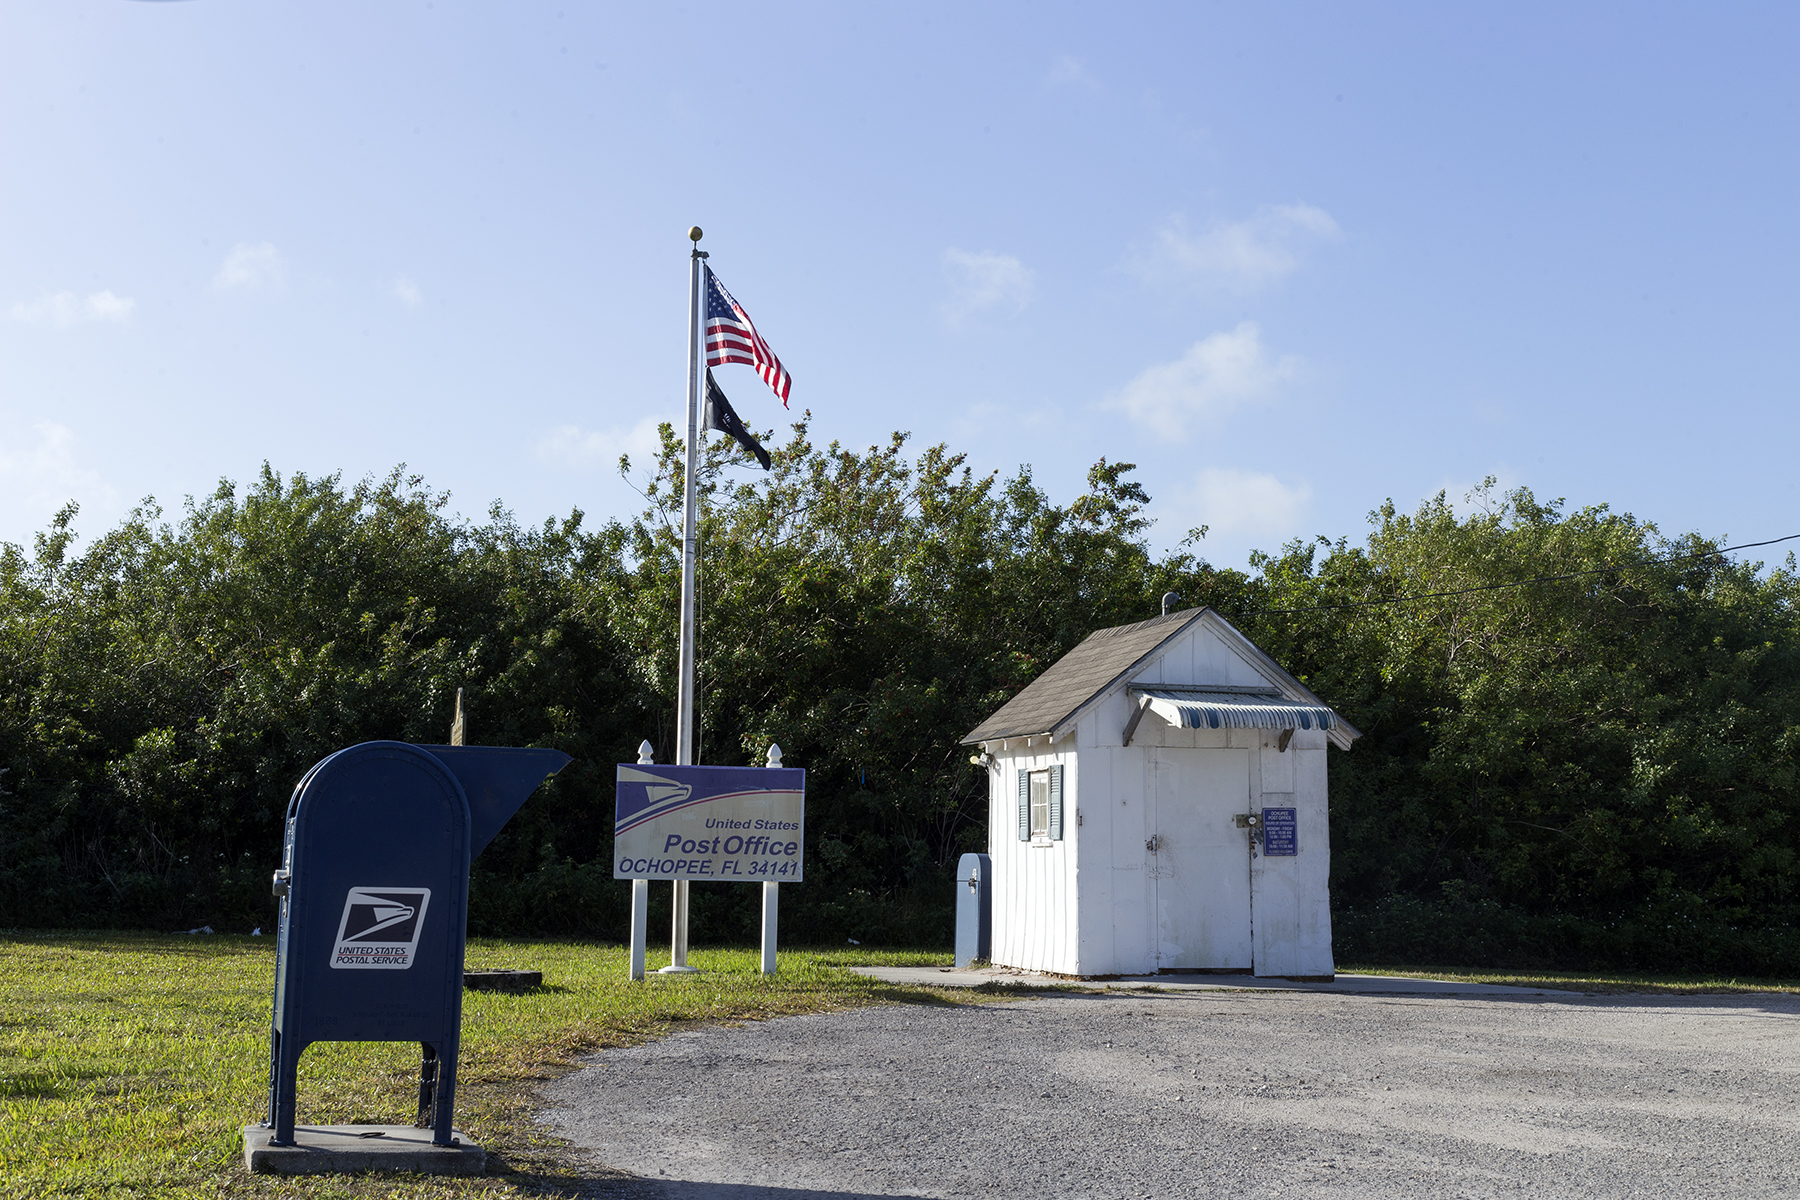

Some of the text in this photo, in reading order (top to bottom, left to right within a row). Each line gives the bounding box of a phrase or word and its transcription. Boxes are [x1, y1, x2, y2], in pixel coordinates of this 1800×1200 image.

[705, 818, 799, 831] United States
[664, 834, 798, 857] Post Office
[619, 858, 798, 877] OCHOPEE, FL 34141
[338, 946, 406, 955] UNITED STATES
[336, 956, 369, 964] POSTAL
